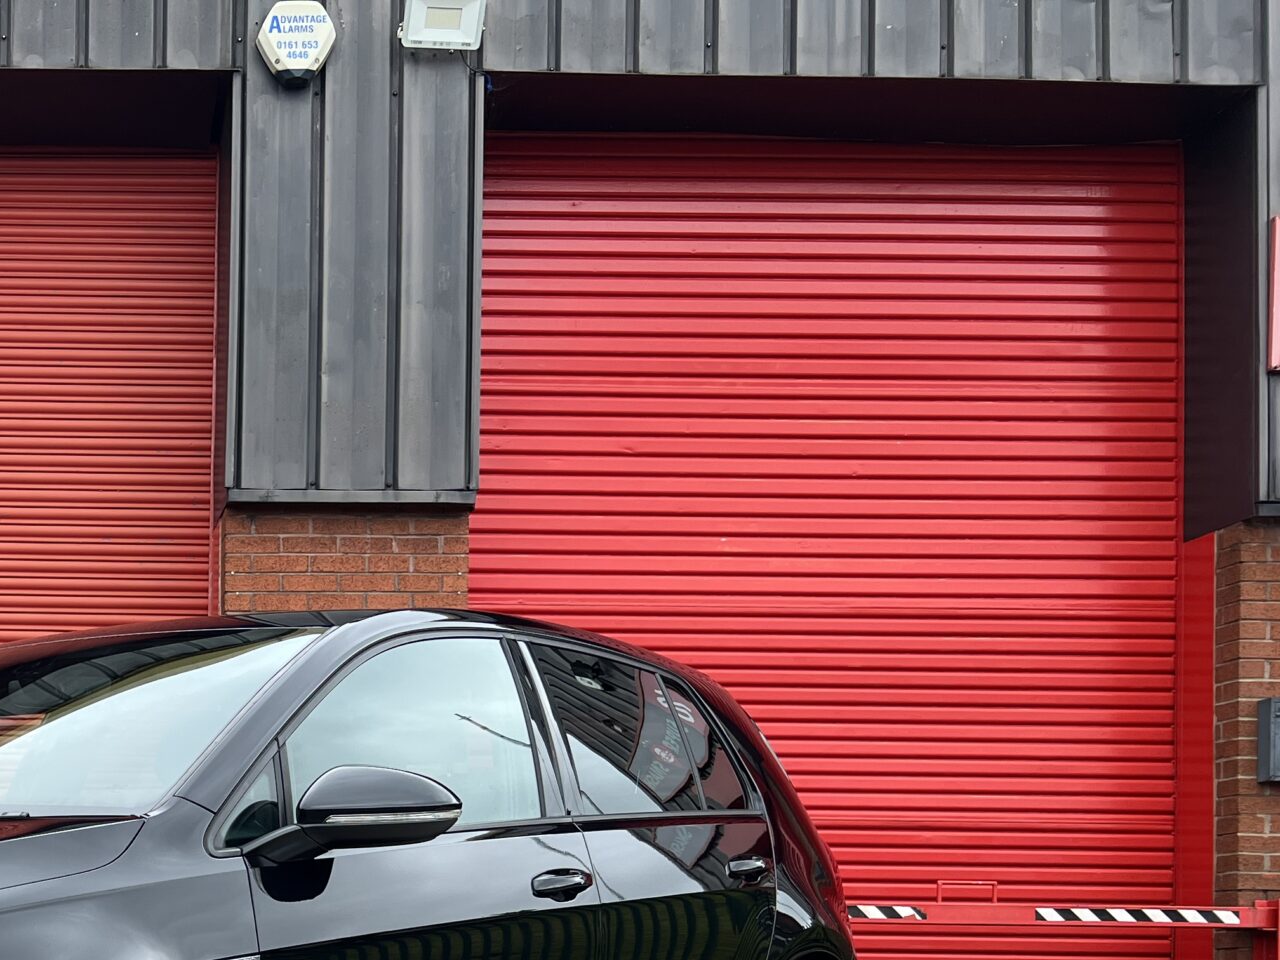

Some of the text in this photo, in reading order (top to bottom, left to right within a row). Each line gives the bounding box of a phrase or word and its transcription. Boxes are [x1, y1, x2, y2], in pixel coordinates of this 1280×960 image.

[268, 15, 327, 33] ADVANTAGE
[276, 40, 319, 49] 0161 653
[286, 50, 309, 59] 4646
